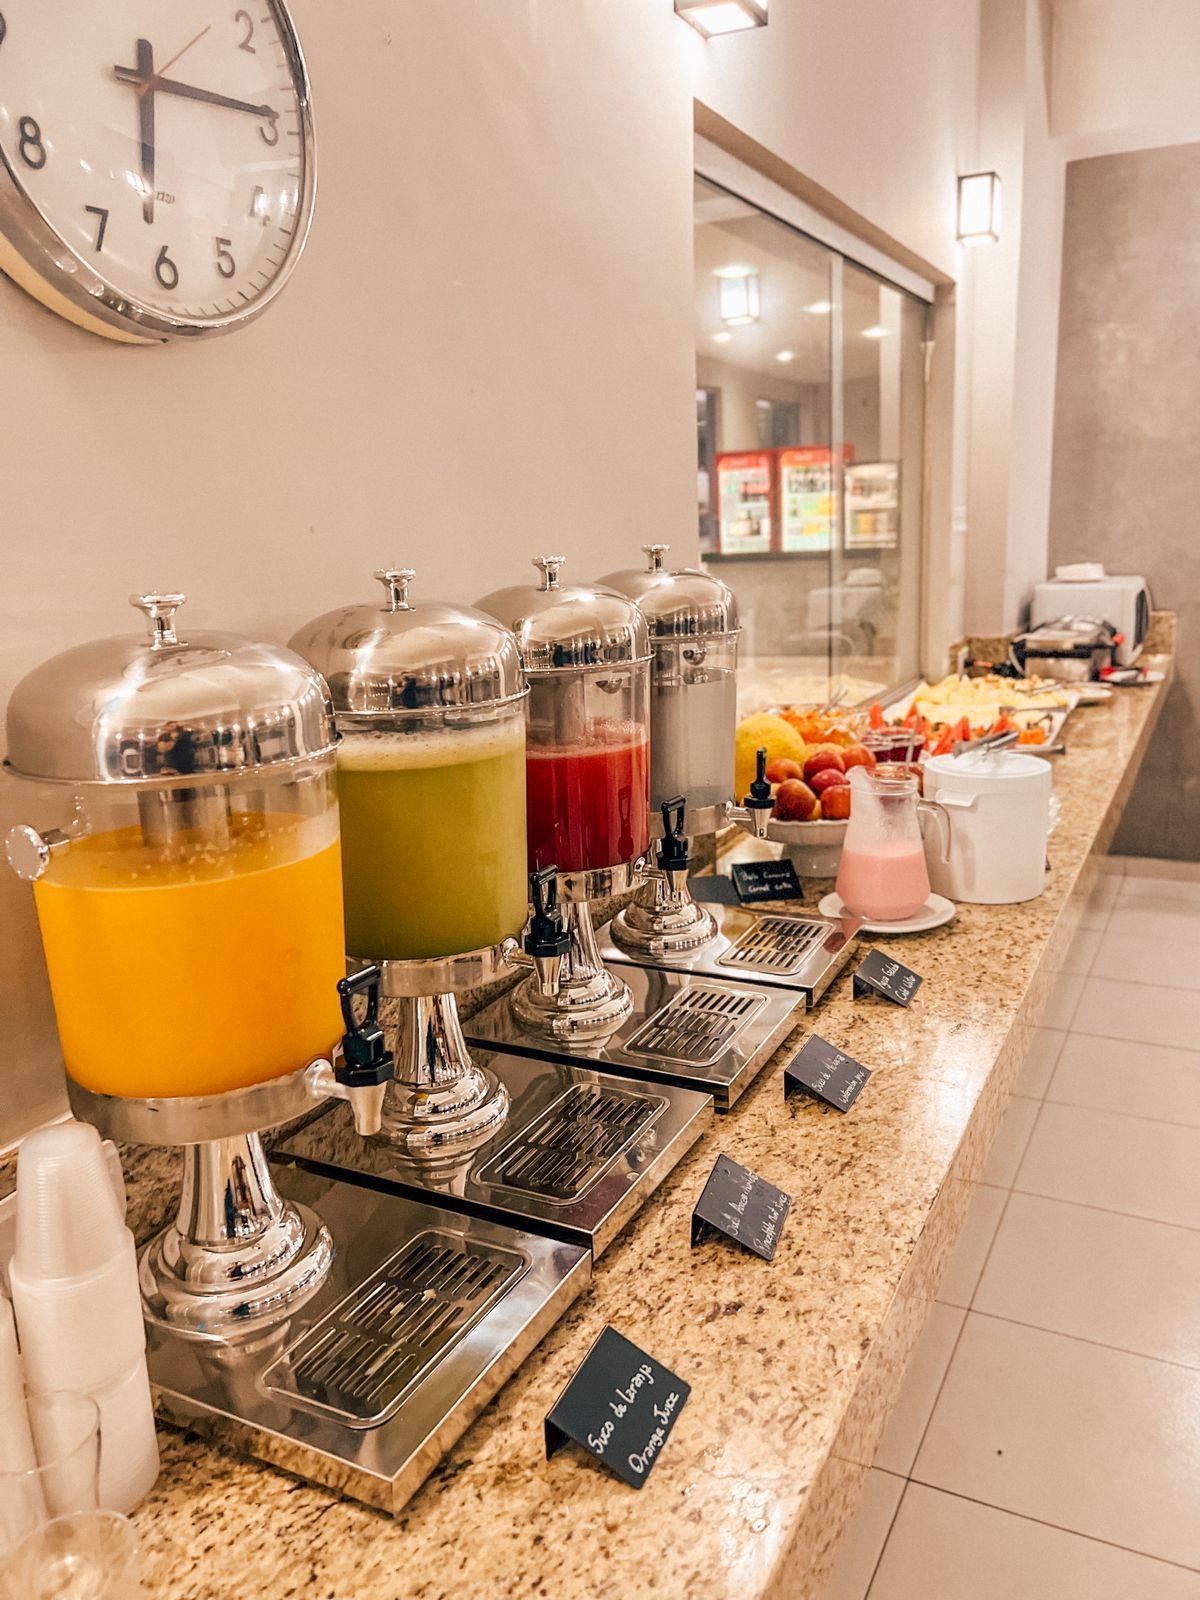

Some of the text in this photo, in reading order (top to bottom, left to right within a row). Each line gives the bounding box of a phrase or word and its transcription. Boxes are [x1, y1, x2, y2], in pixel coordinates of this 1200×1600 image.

[235, 10, 256, 54] 2
[19, 116, 46, 170] 8
[259, 104, 279, 146] 3
[85, 205, 109, 252] 7
[155, 245, 179, 290] 6
[215, 237, 236, 279] 5
[587, 1364, 655, 1455] Suco de Laranja
[628, 1392, 680, 1474] Orange Juice
